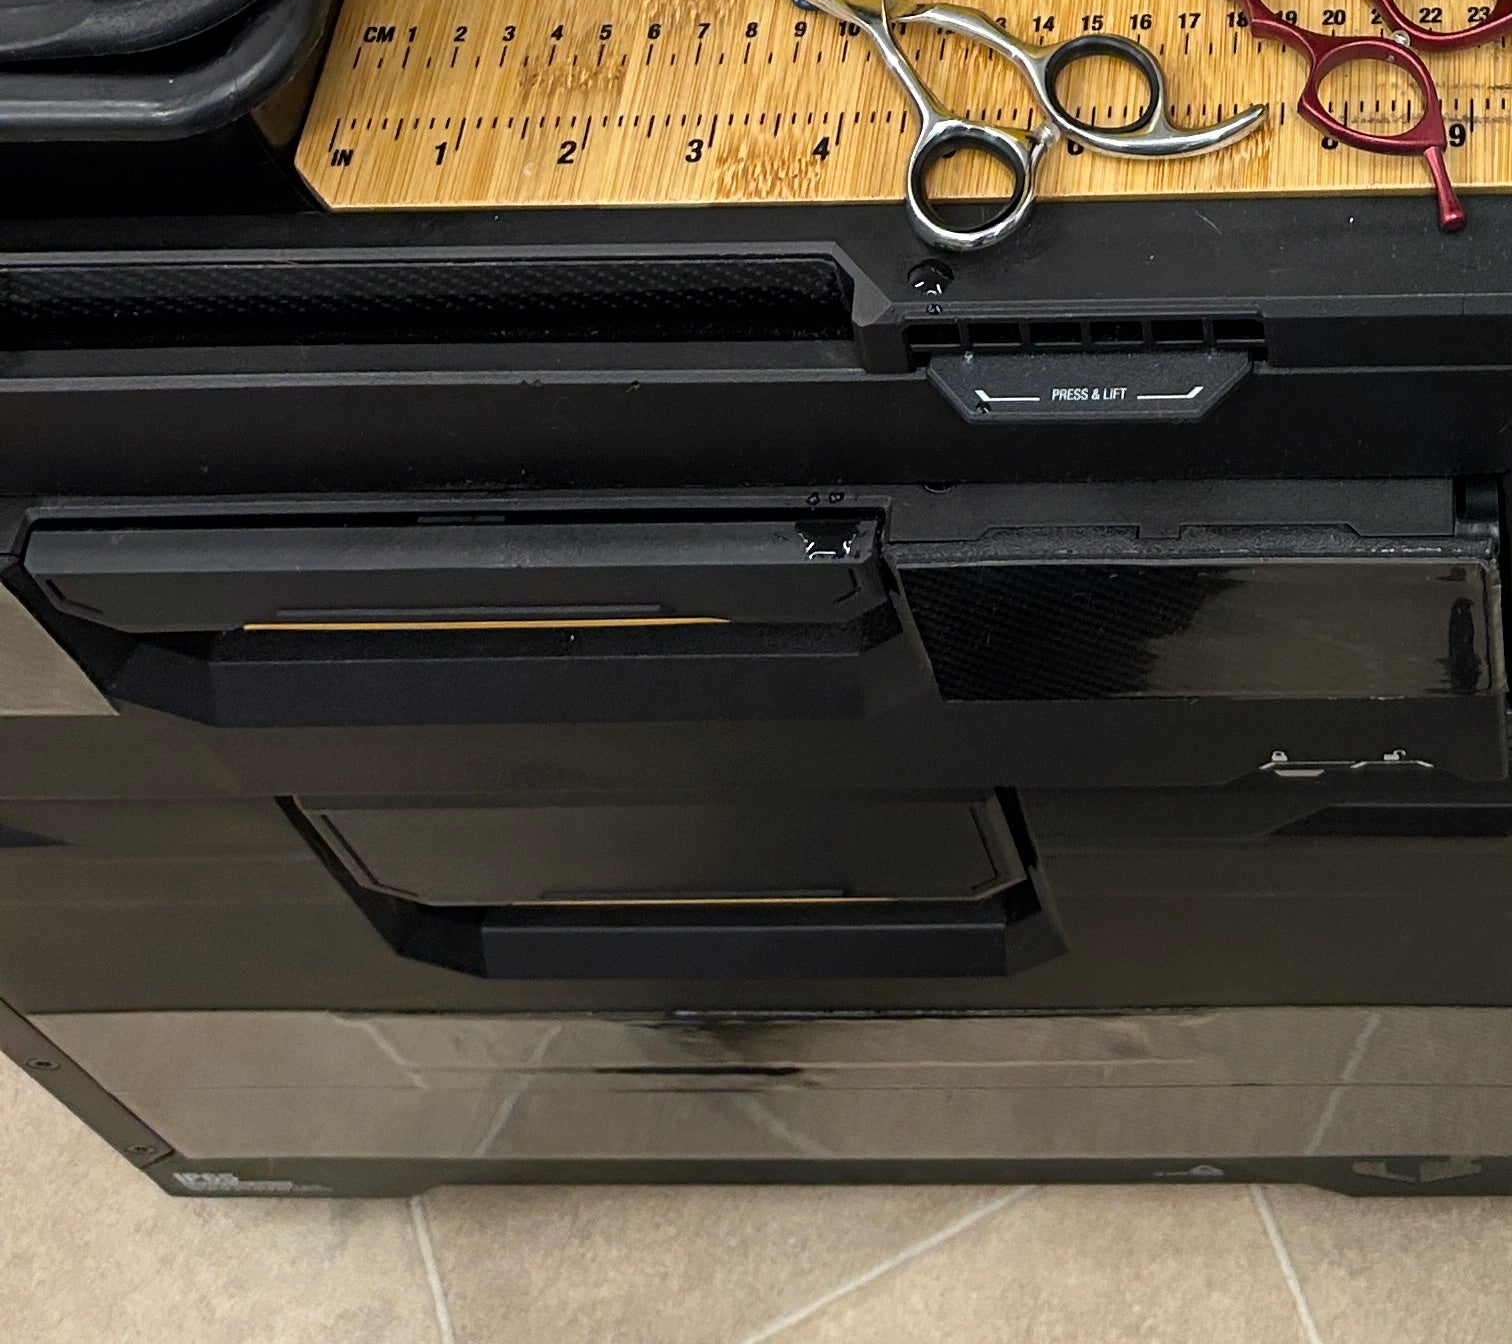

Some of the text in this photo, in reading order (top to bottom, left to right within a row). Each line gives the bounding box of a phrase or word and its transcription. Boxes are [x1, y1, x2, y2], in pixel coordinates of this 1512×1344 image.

[363, 26, 395, 44] CM
[407, 26, 417, 43] 1
[453, 25, 468, 43] 2
[502, 25, 517, 43] 3
[550, 24, 564, 42] 4
[599, 23, 613, 41] 5
[647, 23, 661, 40] 6
[697, 22, 711, 40] 7
[745, 21, 759, 39] 8
[794, 21, 807, 38] 9
[1032, 15, 1055, 33] 14
[1081, 14, 1104, 32] 15
[1130, 13, 1153, 31] 16
[1178, 12, 1201, 30] 17
[1227, 11, 1249, 29] 18
[1322, 9, 1346, 26] 20
[1418, 6, 1443, 24] 22
[1467, 6, 1491, 23] 23
[330, 150, 354, 168] IN
[434, 143, 447, 166] 1
[557, 142, 577, 165] 2
[685, 139, 704, 163] 3
[811, 137, 831, 161] 4
[1447, 123, 1467, 148] 9
[1051, 388, 1128, 401] PRESS & LIFT
